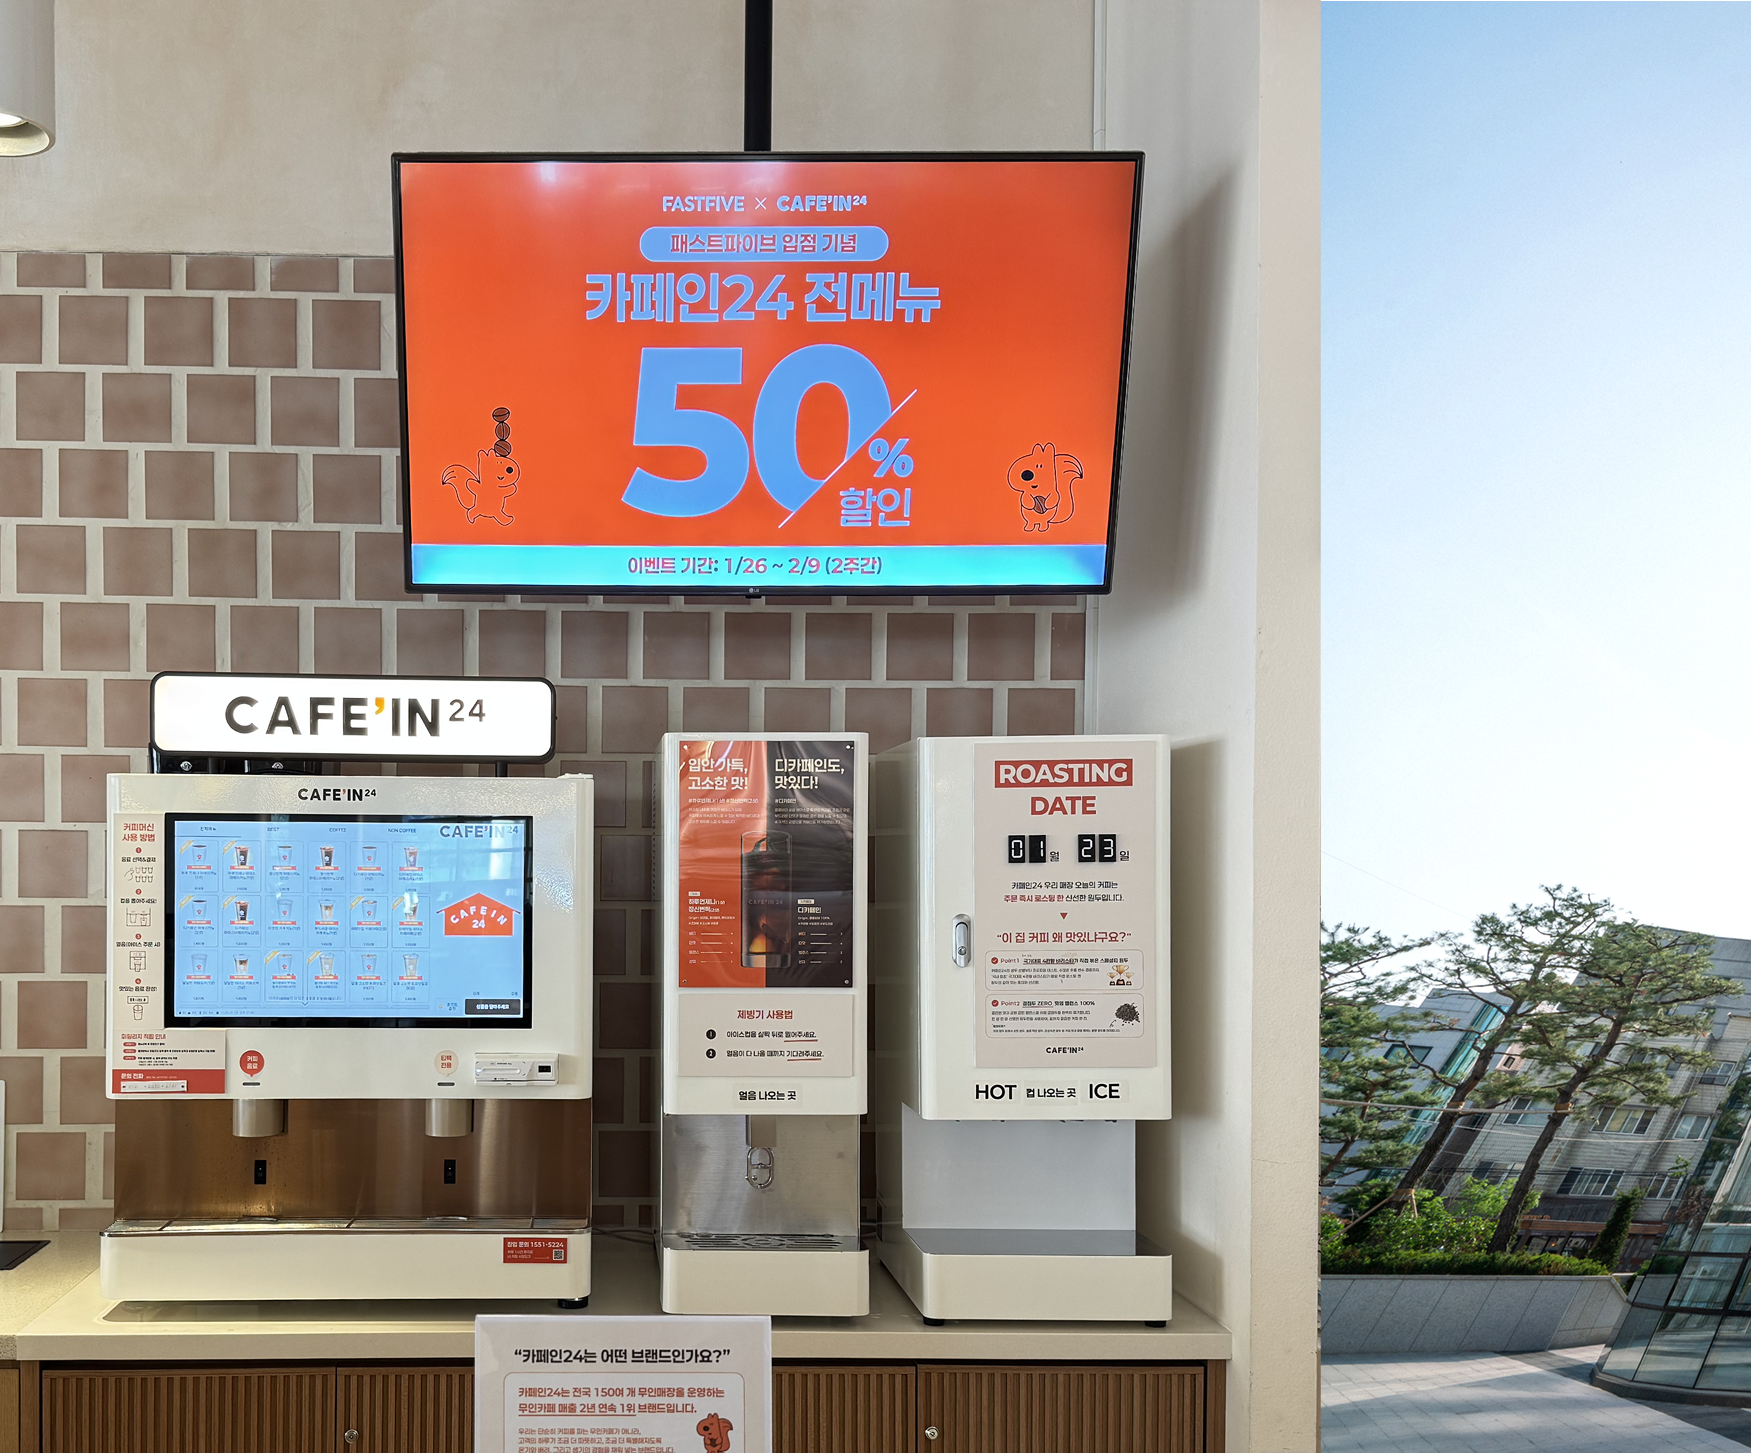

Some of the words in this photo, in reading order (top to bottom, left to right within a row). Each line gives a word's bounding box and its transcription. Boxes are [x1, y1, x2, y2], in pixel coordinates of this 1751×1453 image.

[662, 195, 745, 212] FASTFIVE
[670, 233, 777, 253] 패스트파이브
[782, 233, 817, 253] 입점
[822, 233, 857, 253] 기념
[585, 272, 795, 323] 카페인24
[804, 272, 941, 323] 전메뉴
[839, 487, 911, 527] 할인
[627, 556, 676, 575] 이벤트
[681, 556, 719, 575] 기간:
[725, 556, 768, 575] 1/26
[788, 556, 821, 575] 2/9
[825, 556, 882, 575] (2주간)
[688, 758, 716, 773] 입안
[718, 758, 748, 773] 가득,
[774, 758, 845, 774] 디카페인도,
[999, 763, 1128, 784] ROASTING
[688, 776, 728, 790] 고소한
[731, 776, 748, 790] 맛!
[774, 775, 819, 790] 맛있다!
[1030, 795, 1097, 816] DATE
[123, 823, 155, 832] 커피머신
[122, 834, 138, 842] 사용
[139, 834, 155, 842] 방법
[1011, 881, 1043, 890] 카페인24
[1044, 881, 1058, 890] 우리
[1059, 881, 1074, 890] 매장
[1075, 881, 1096, 890] 오늘의
[1097, 881, 1118, 890] 커피는
[1003, 894, 1018, 902] 주문
[1019, 894, 1033, 902] 즉시
[1034, 894, 1055, 902] 로스팅
[1056, 894, 1064, 902] 한
[1065, 894, 1086, 902] 신선한
[1087, 894, 1124, 902] 원두입니다.
[797, 906, 821, 914] 디카페인
[472, 919, 486, 929] 24
[1015, 931, 1025, 943] 집
[1028, 931, 1049, 943] 커피
[1052, 931, 1063, 943] 왜
[737, 1009, 764, 1020] 제빙기
[766, 1009, 794, 1020] 사용법
[738, 1091, 756, 1101] 얼음
[758, 1091, 785, 1101] 나오는
[787, 1091, 797, 1101] 곳
[975, 1084, 1018, 1100] HOT
[1025, 1088, 1035, 1099] 컵
[1037, 1088, 1065, 1099] 나오는
[1067, 1088, 1077, 1099] 곳
[1088, 1083, 1121, 1099] ICE
[600, 1348, 627, 1364] 어떤
[518, 1387, 570, 1397] 카페인24는
[572, 1387, 591, 1397] 전국
[594, 1387, 624, 1397] 150여
[626, 1387, 636, 1397] 개
[638, 1387, 685, 1397] 무인매장을
[687, 1387, 725, 1397] 운영하는
[518, 1403, 556, 1413] 무인카페
[558, 1403, 577, 1413] 매출
[579, 1403, 596, 1413] 2년
[598, 1403, 617, 1413] 연속
[620, 1403, 635, 1413] 1위
[638, 1403, 697, 1413] 브랜드입니다.
